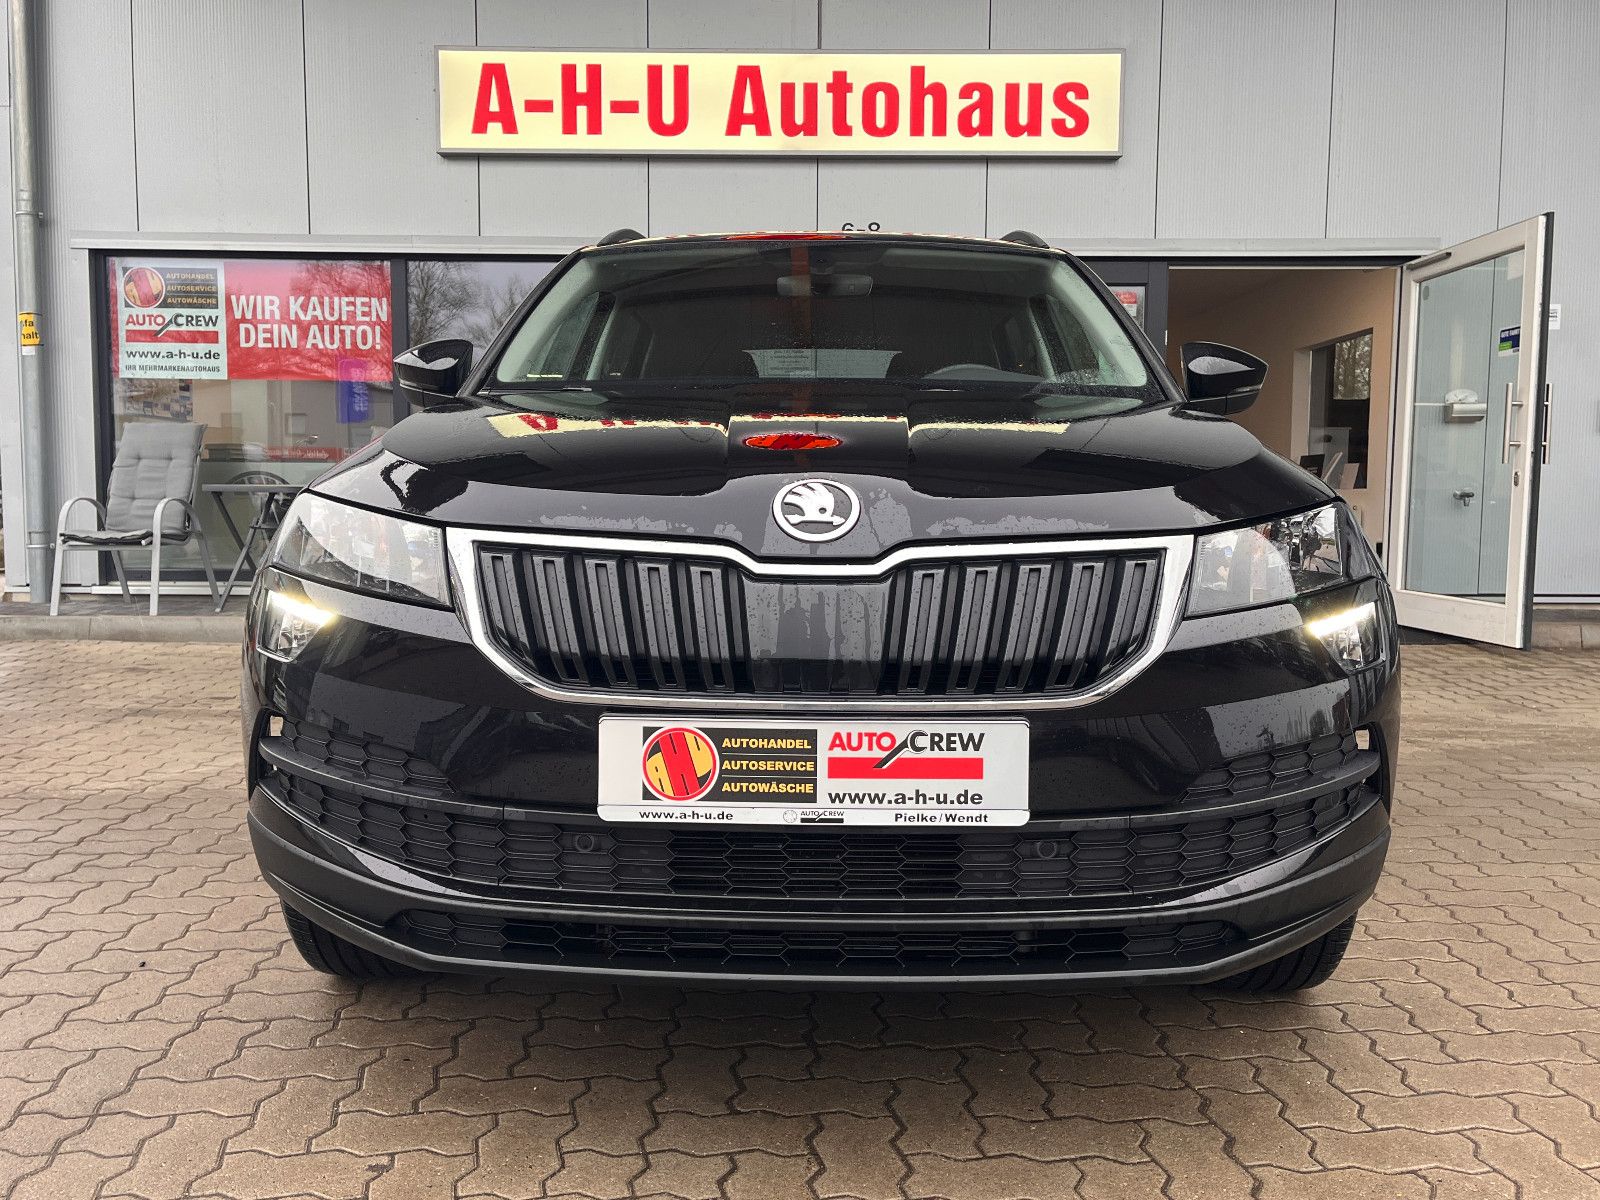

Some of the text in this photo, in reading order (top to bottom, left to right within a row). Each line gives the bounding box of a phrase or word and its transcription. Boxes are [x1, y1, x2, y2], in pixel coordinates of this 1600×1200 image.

[471, 62, 1090, 138] A-H-U Autohaus
[166, 272, 215, 280] AUTOHANDEL
[166, 283, 217, 292] AUTOSERVICE
[167, 294, 217, 304] AUTOWÄSCHE
[230, 294, 388, 322] WIR KAUFEN
[125, 312, 219, 327] AUTO CREW
[239, 323, 382, 350] DEIN AUTO!
[126, 348, 220, 360] www.a-h-u.de
[138, 364, 220, 373] MEHRMARKENAUTOHAUS
[722, 737, 812, 749] AUTOHANDEL
[828, 730, 986, 753] AUTO CREW
[721, 760, 815, 772] AUTOSERVICE
[721, 781, 814, 793] AUTOWÄSCHE
[827, 789, 984, 805] www.a-h-u.de
[638, 810, 734, 821] www.a-h-u.de
